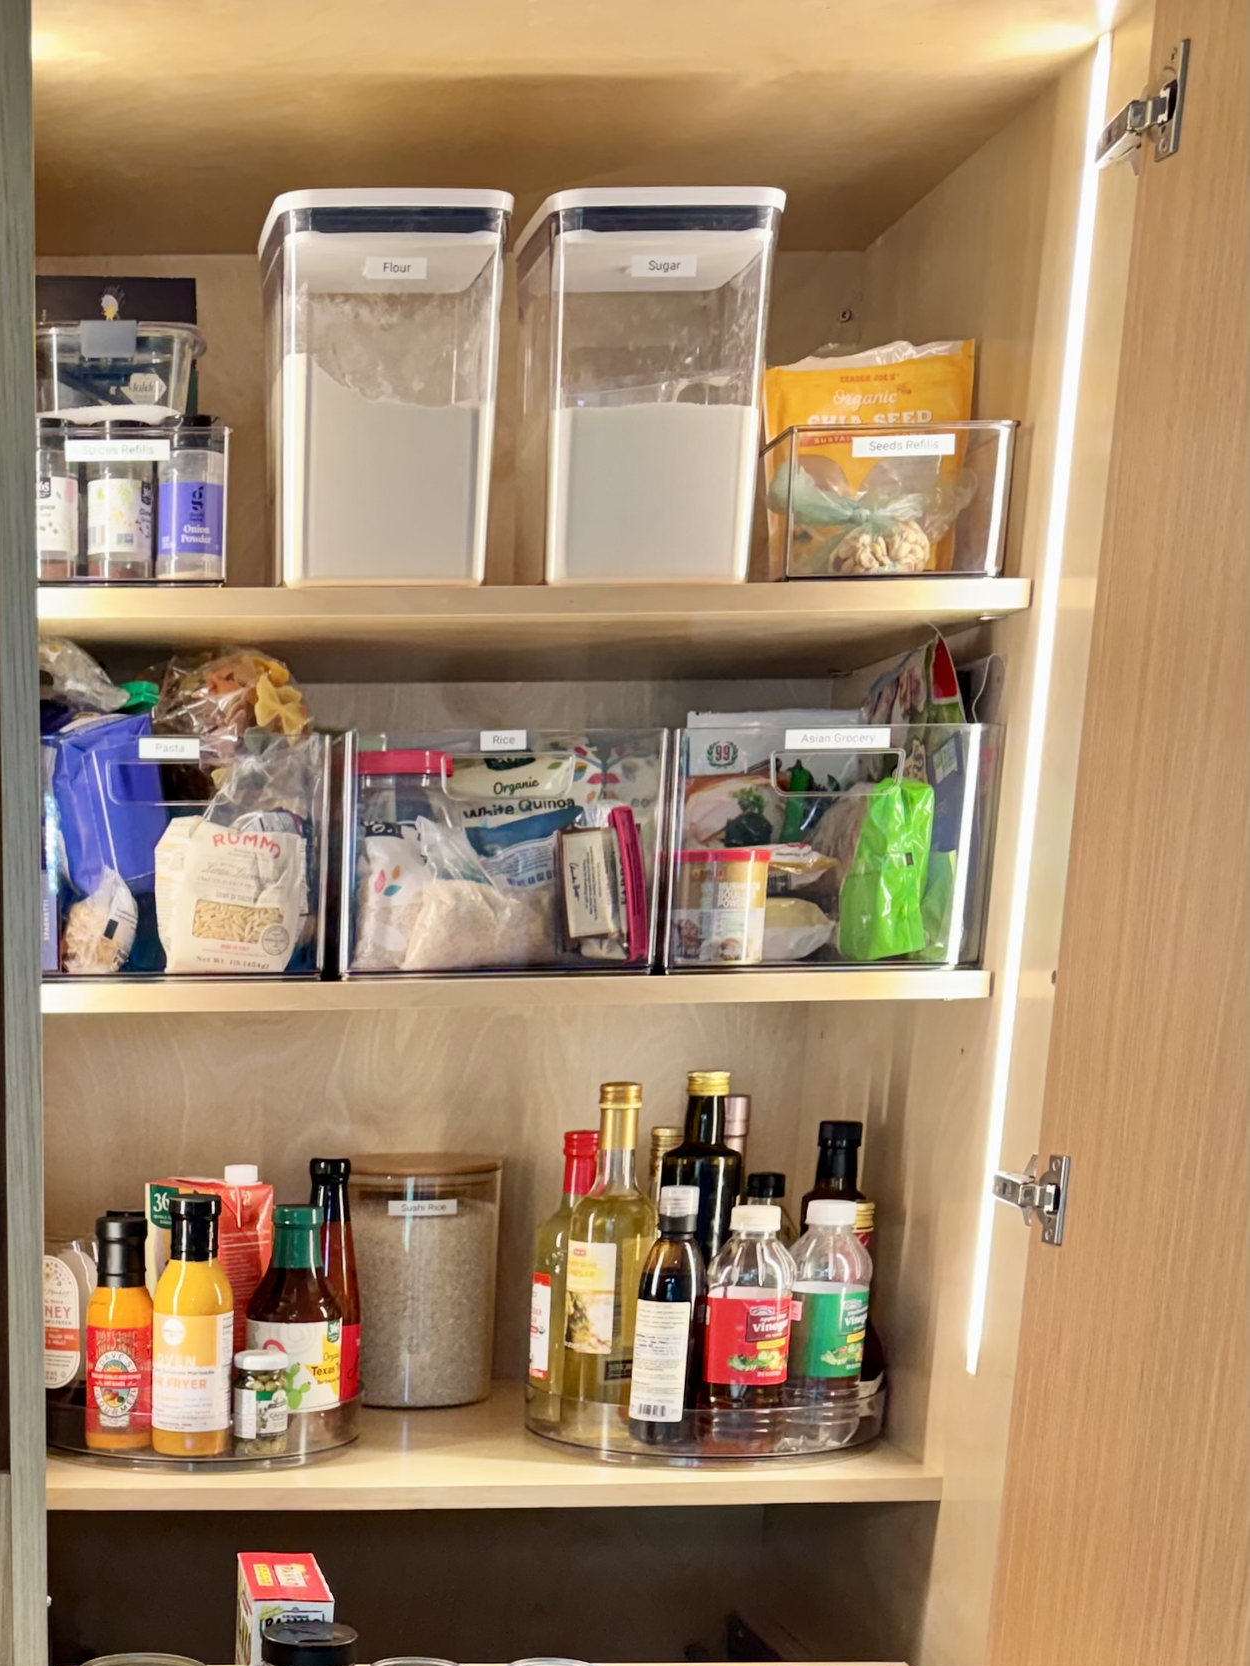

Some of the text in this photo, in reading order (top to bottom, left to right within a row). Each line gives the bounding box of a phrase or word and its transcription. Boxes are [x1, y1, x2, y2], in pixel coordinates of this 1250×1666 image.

[383, 261, 412, 274] Flour
[648, 259, 681, 273] Sugar
[833, 389, 898, 411] Organic
[873, 410, 933, 424] SEED
[121, 444, 154, 456] Refills
[869, 440, 939, 452] Seeds Refills
[183, 525, 210, 535] Onion
[181, 535, 212, 545] Powder
[492, 735, 515, 745] Rice
[801, 732, 875, 745] Asian Grocery
[155, 743, 185, 753] Pasta
[493, 777, 539, 796] Organic
[518, 798, 576, 812] Quinoa
[400, 1203, 447, 1213] Sushi Rice
[311, 1365, 335, 1377] Texas
[166, 1379, 207, 1390] FRYER
